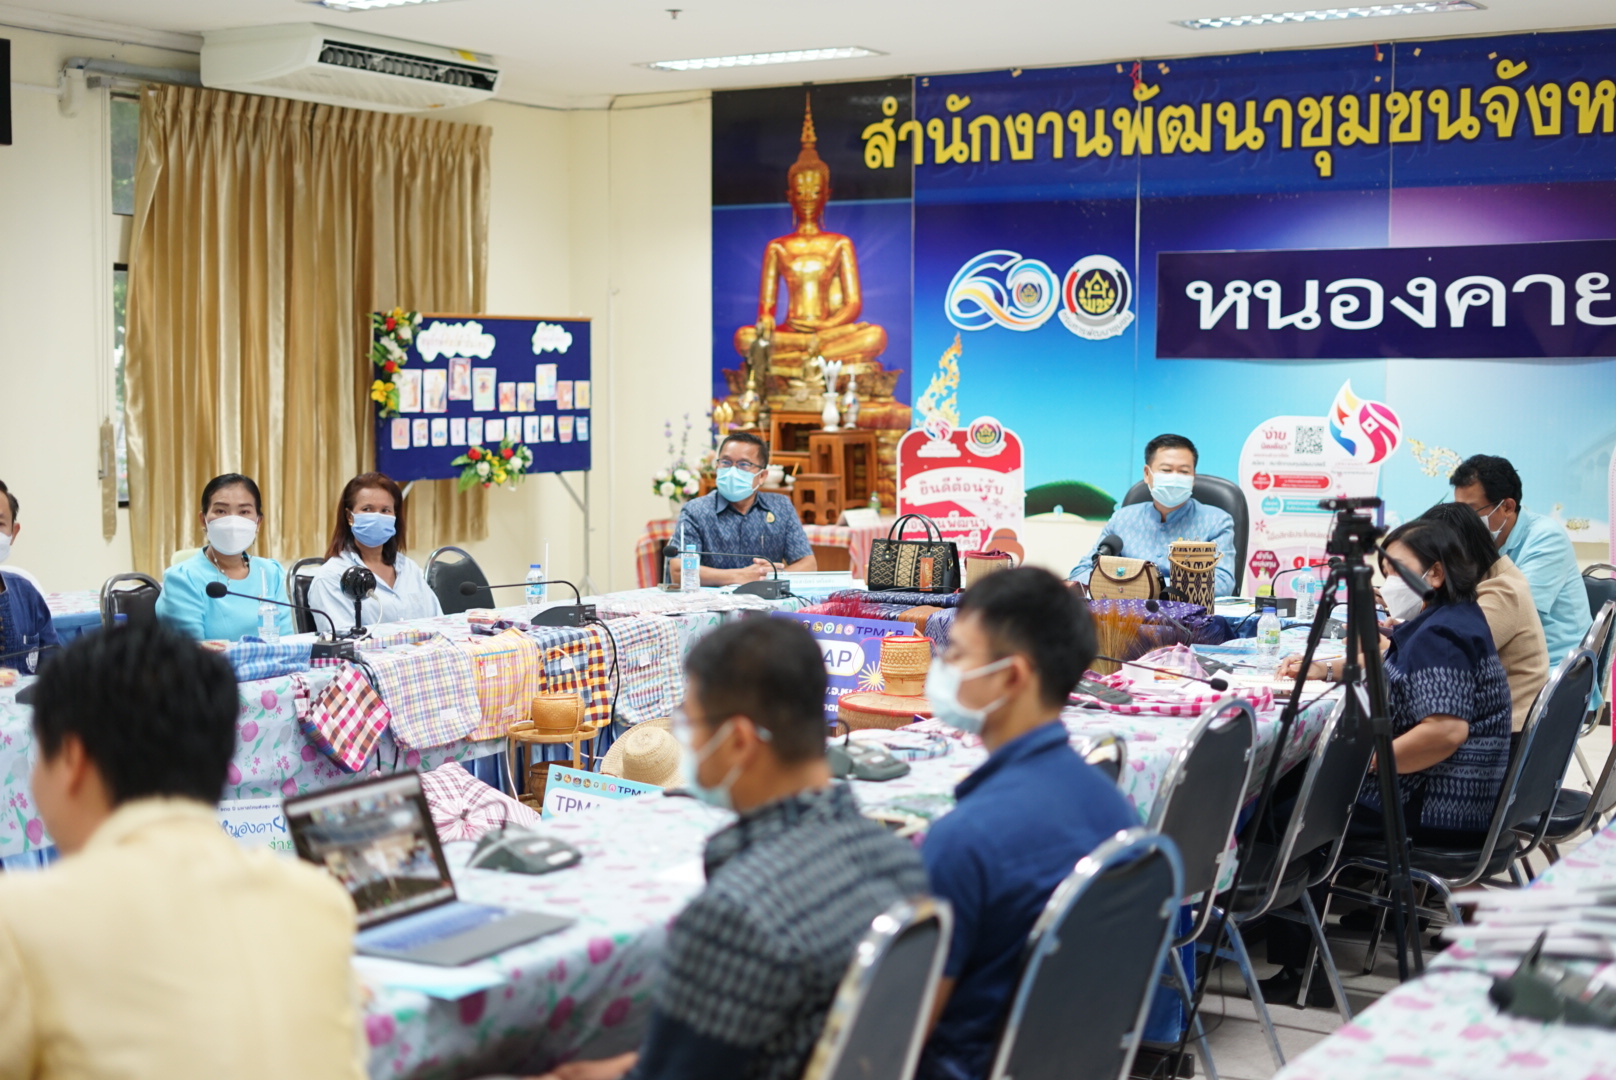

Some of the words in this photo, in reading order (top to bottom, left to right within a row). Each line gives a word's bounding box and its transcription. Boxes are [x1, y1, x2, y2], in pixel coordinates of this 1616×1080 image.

[1185, 271, 1616, 331] หนองคาย
[618, 786, 647, 797] TPM
[555, 795, 600, 813] TPM
